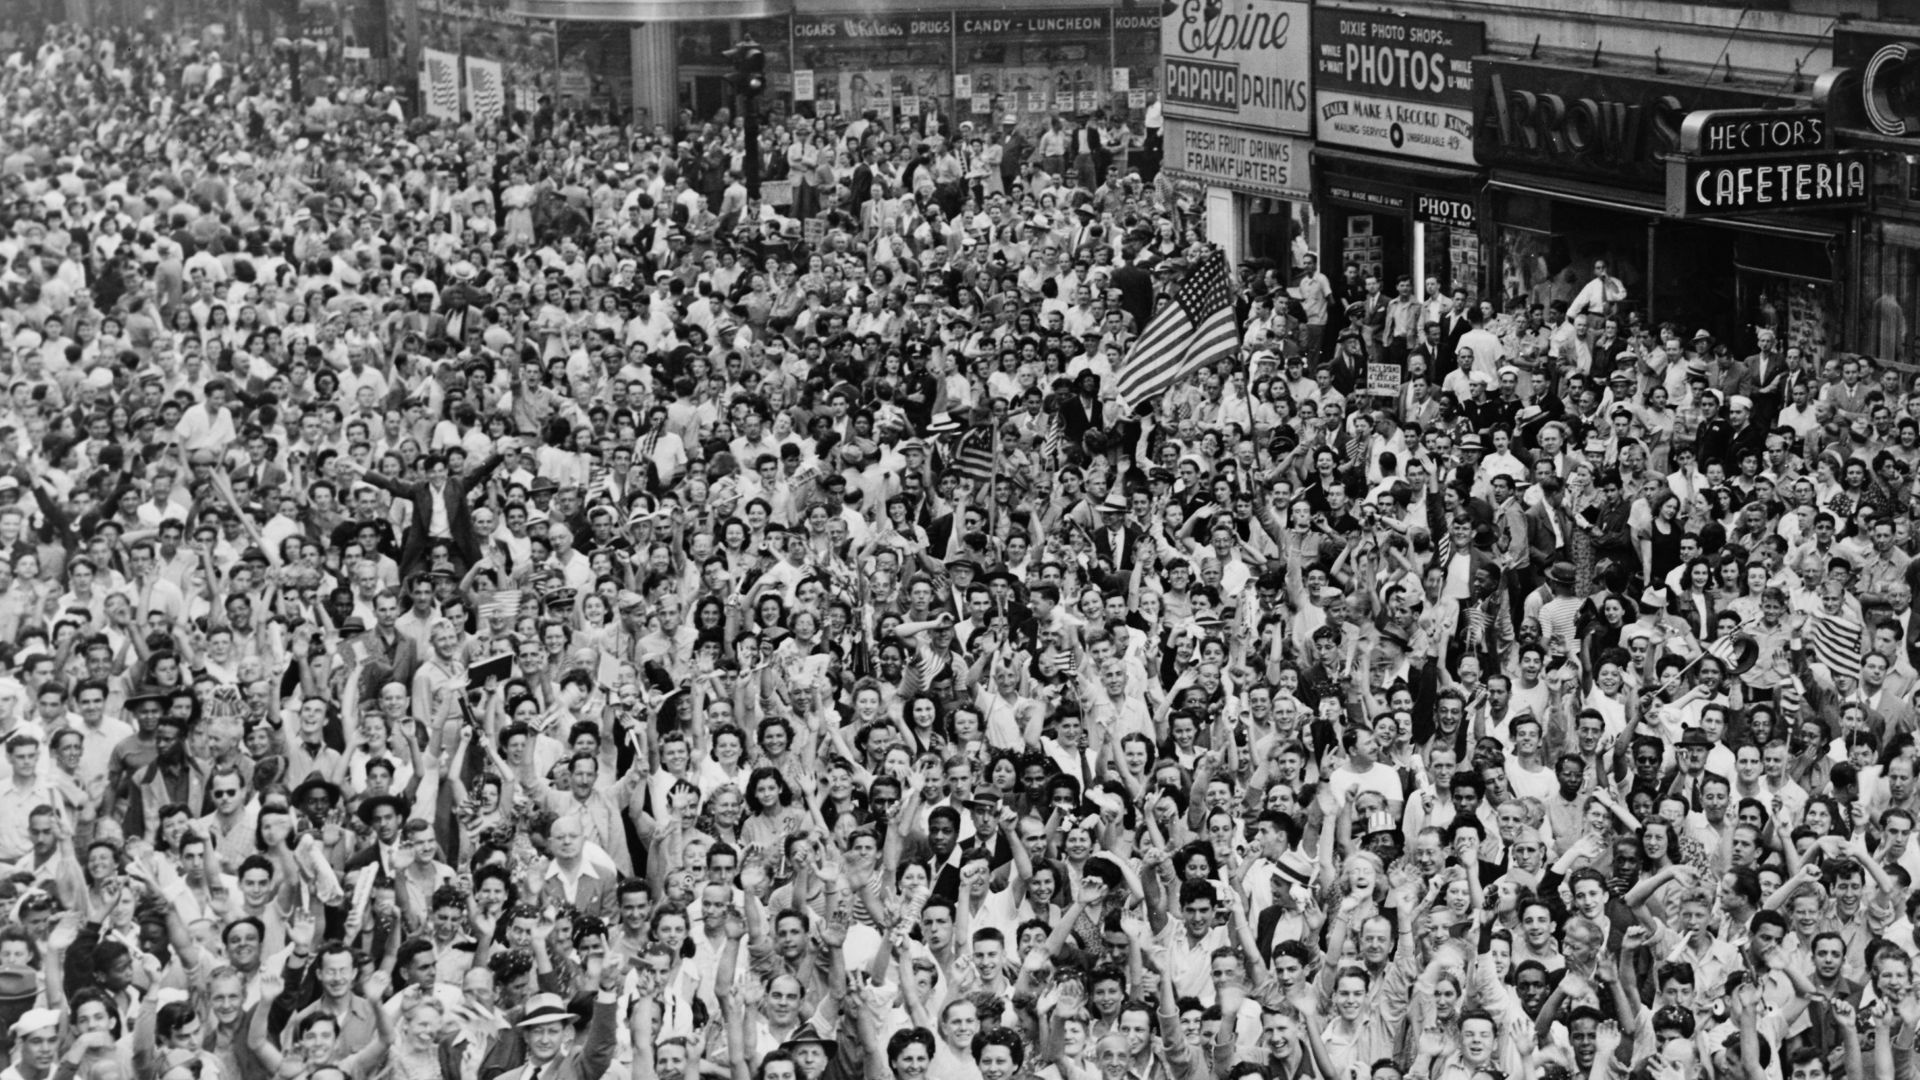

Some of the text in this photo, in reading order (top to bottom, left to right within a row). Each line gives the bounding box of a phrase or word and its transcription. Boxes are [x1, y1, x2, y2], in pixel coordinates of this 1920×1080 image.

[794, 24, 836, 37] CIGARS
[910, 21, 951, 34] DRUGS
[963, 19, 1011, 33] CANDY
[1028, 17, 1102, 32] LUNCHEON
[1340, 20, 1367, 37] DIXIE
[1371, 23, 1405, 41] PHOTO
[1321, 44, 1341, 57] WHILE
[1346, 43, 1445, 93] PHOTOS
[1450, 59, 1472, 74] WHILE
[1167, 64, 1236, 104] PAPAYA
[1241, 73, 1307, 112] DRINKS
[1352, 100, 1439, 128] MAKE A RECORD
[1334, 122, 1388, 139] MAILING SERVICE
[1406, 132, 1445, 147] UNBREAKABLE
[1710, 119, 1822, 150] HECTOR'S
[1185, 130, 1290, 162] FRESH FRUIT DRINKS
[1187, 152, 1288, 184] FRANKFURTERS
[1696, 161, 1864, 206] CAFETERIA
